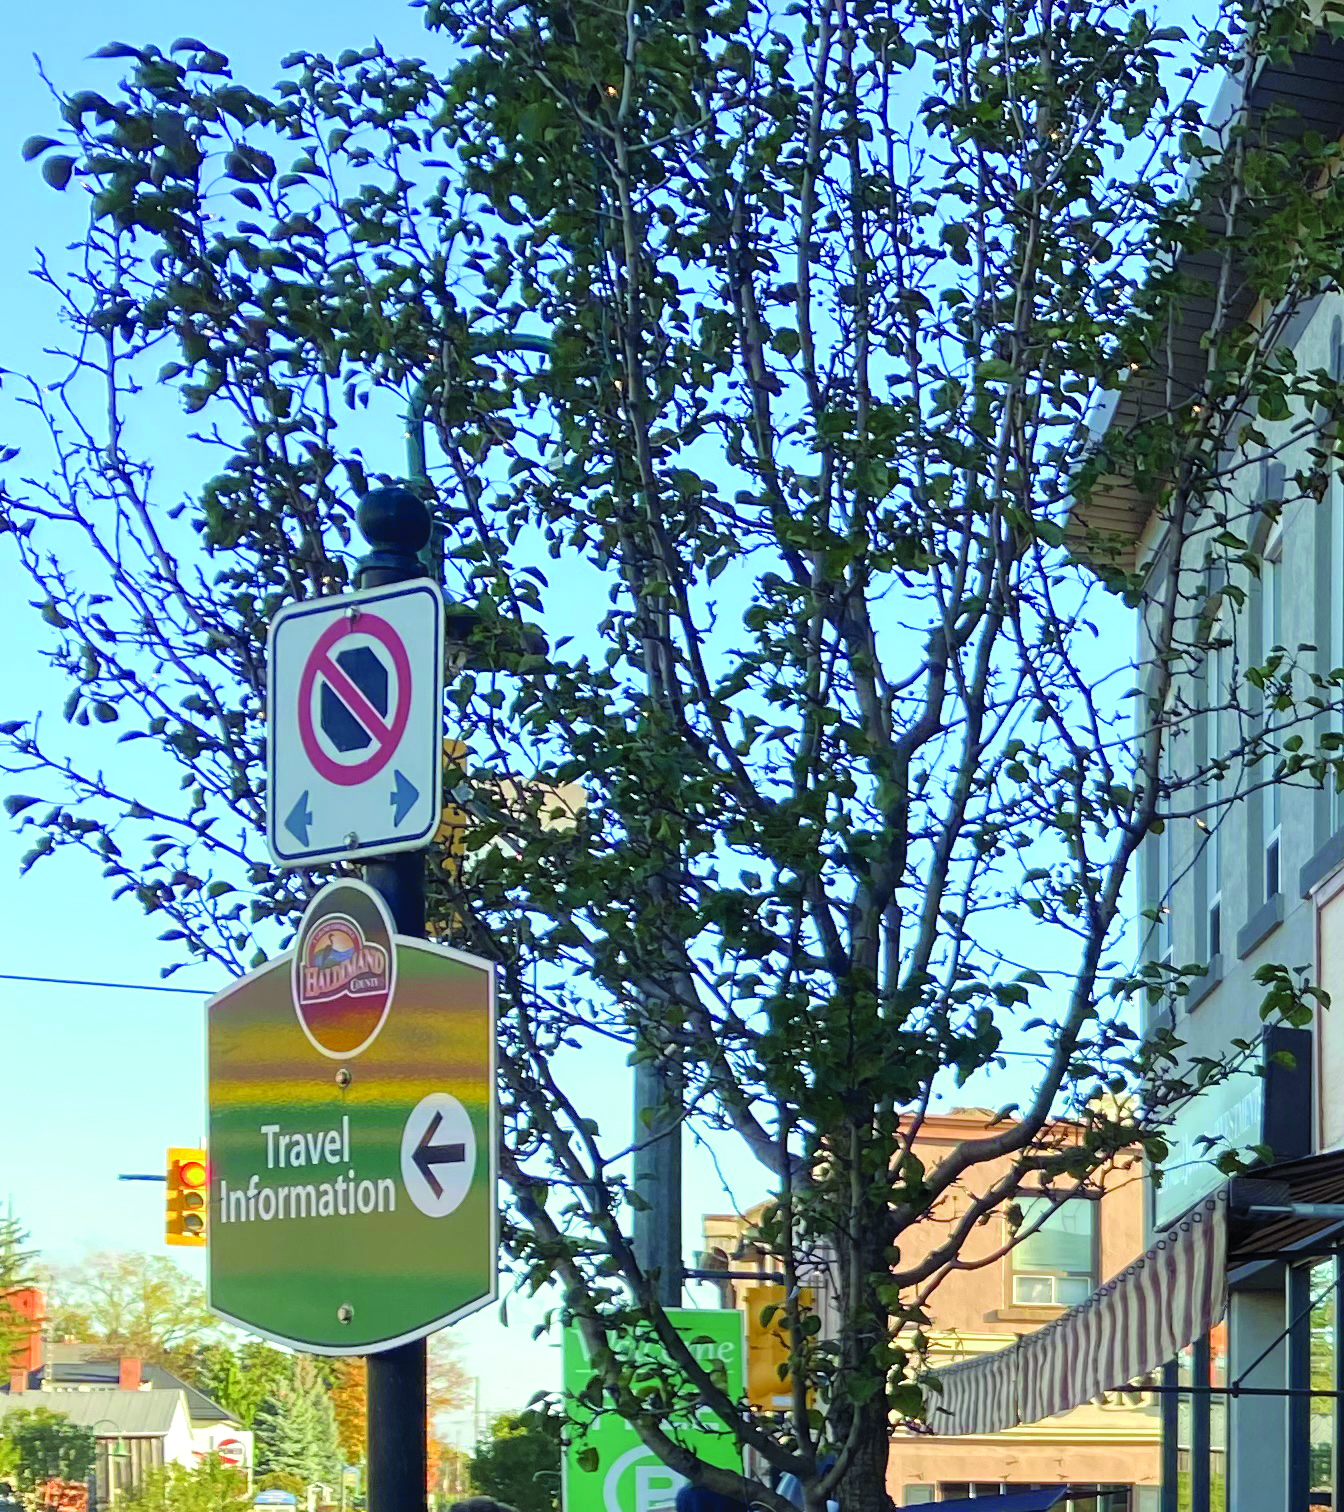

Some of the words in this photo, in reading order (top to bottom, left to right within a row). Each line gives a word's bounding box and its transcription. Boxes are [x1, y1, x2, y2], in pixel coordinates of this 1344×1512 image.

[304, 948, 385, 997] HALDIMAND
[260, 1115, 350, 1169] Travel
[220, 1169, 396, 1223] Information
